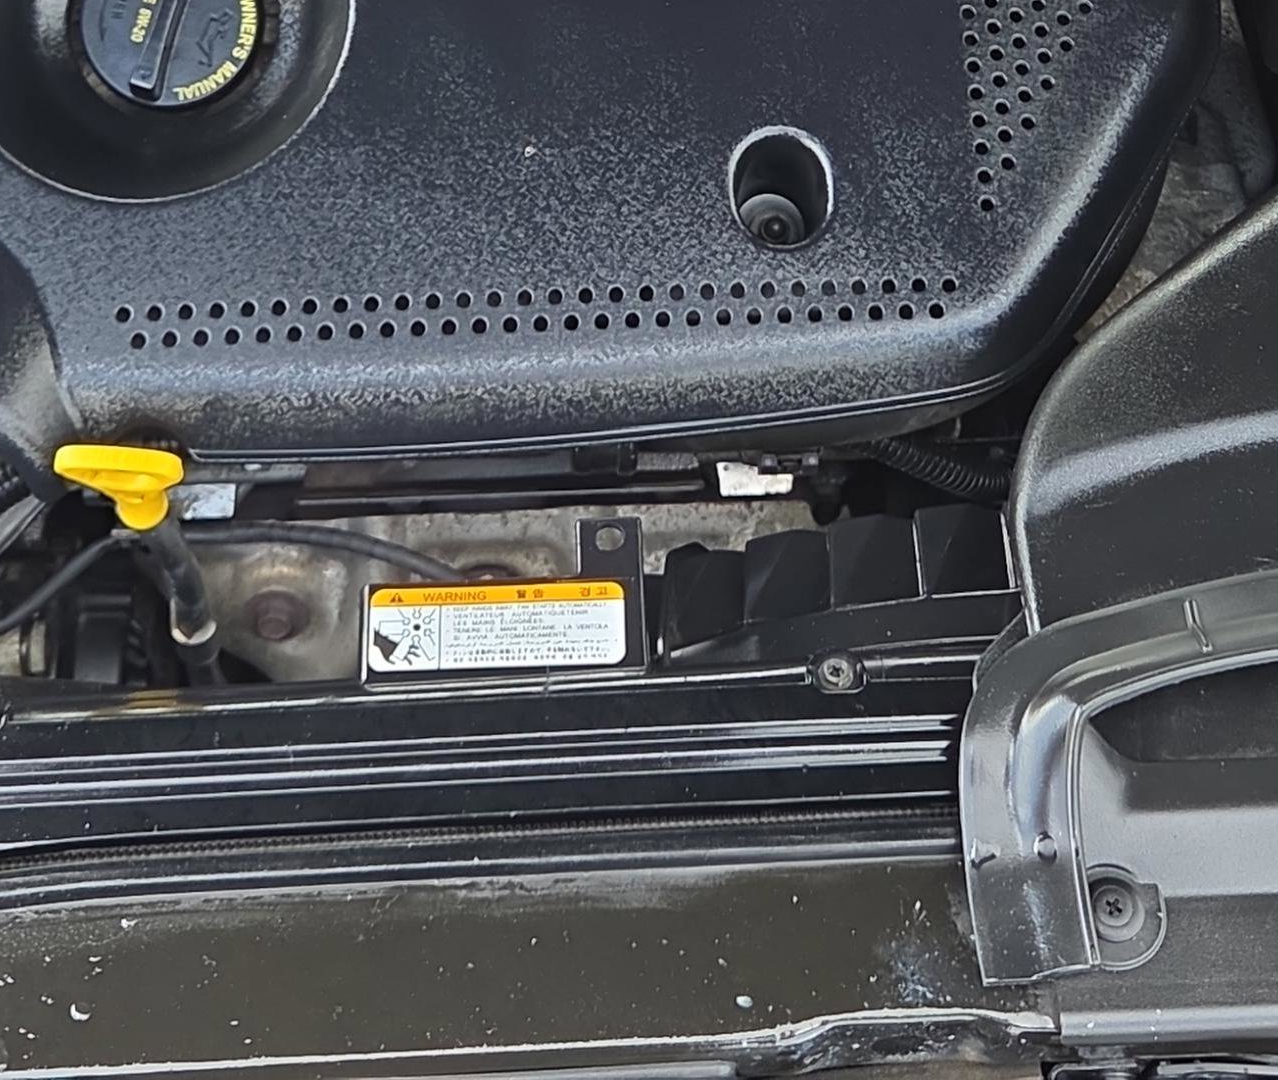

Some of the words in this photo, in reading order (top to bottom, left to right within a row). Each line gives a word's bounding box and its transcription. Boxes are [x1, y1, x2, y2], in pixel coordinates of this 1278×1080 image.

[173, 60, 238, 101] MANUAL
[423, 590, 487, 602] WARNING
[453, 611, 505, 619] VENTILATEUR
